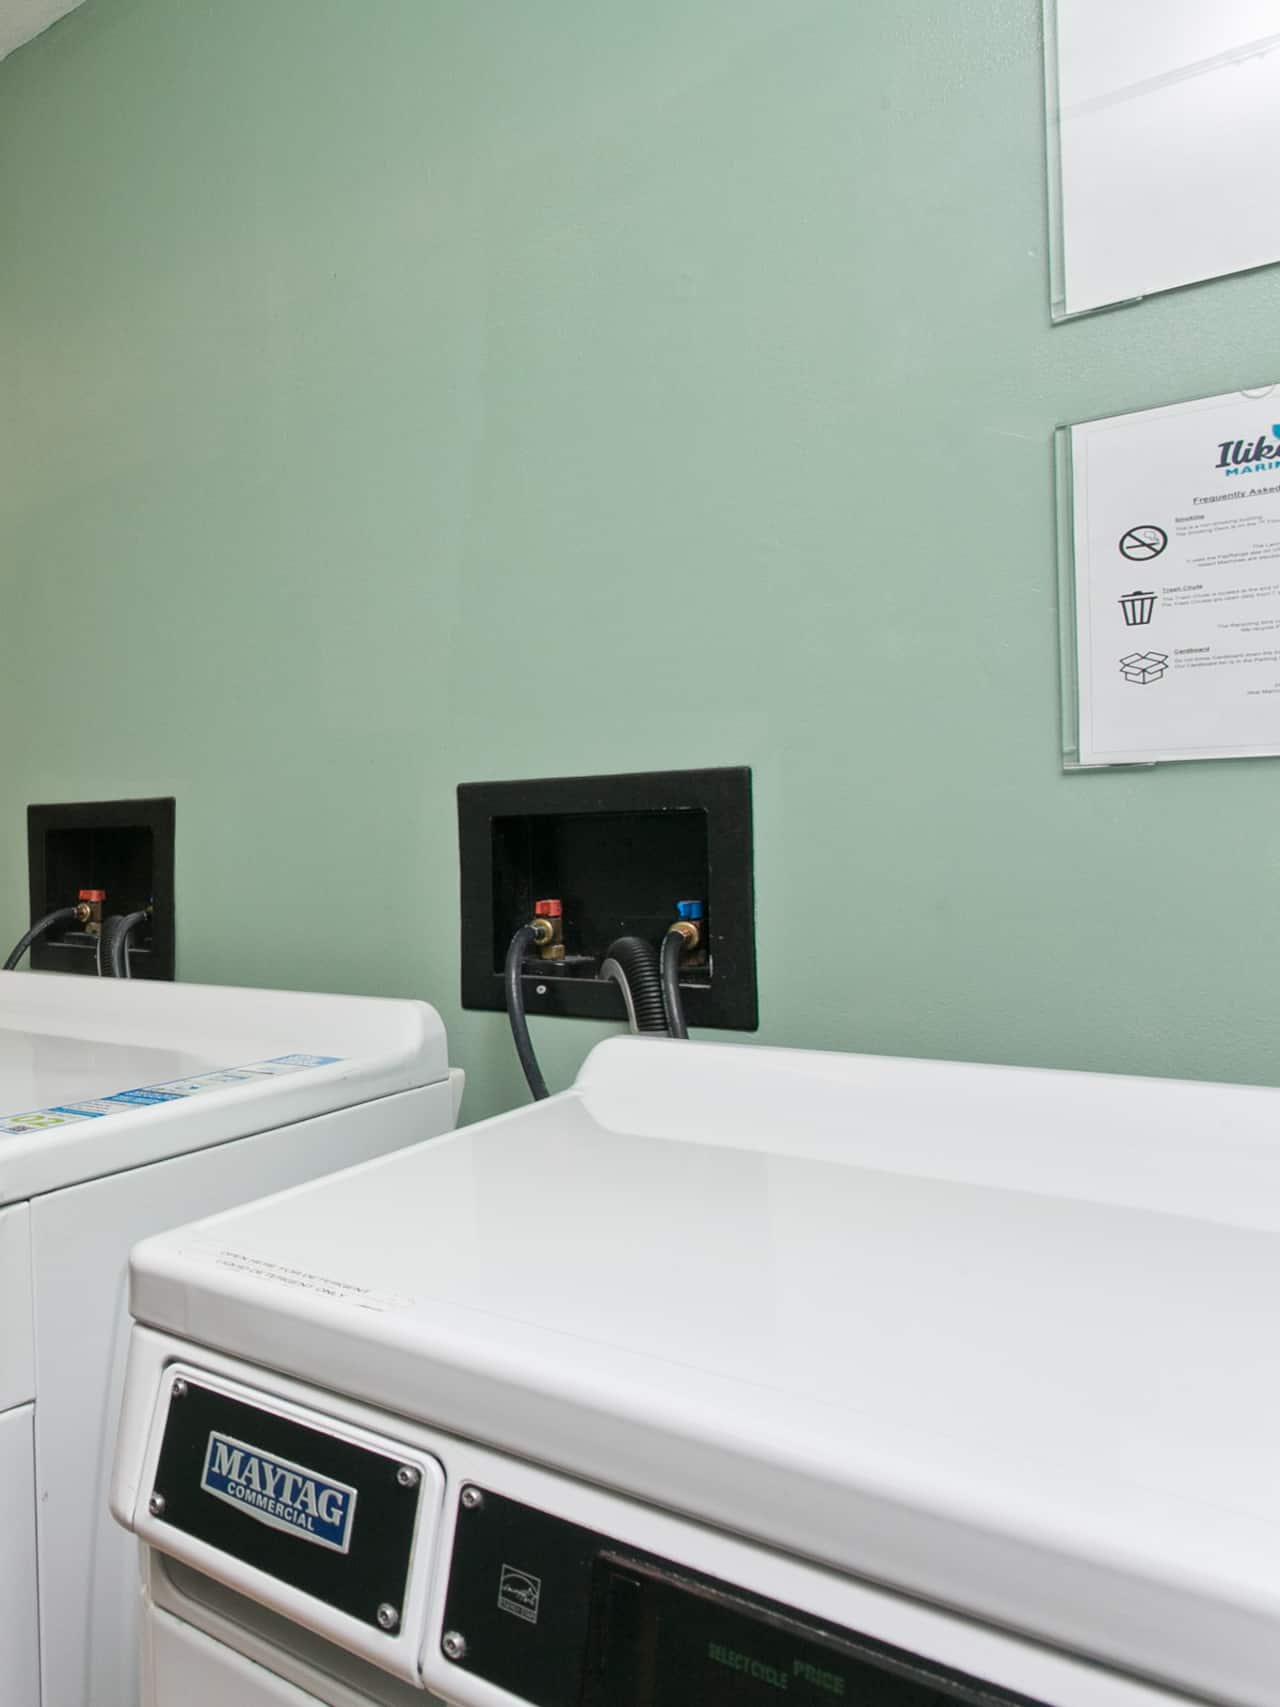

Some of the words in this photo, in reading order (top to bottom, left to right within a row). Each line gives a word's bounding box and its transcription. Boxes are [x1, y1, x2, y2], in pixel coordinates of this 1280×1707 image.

[1193, 490, 1246, 505] Frequently
[211, 1442, 344, 1527] MAYTAG
[227, 1481, 315, 1531] COMMERCIAL
[793, 1656, 846, 1695] PRICE
